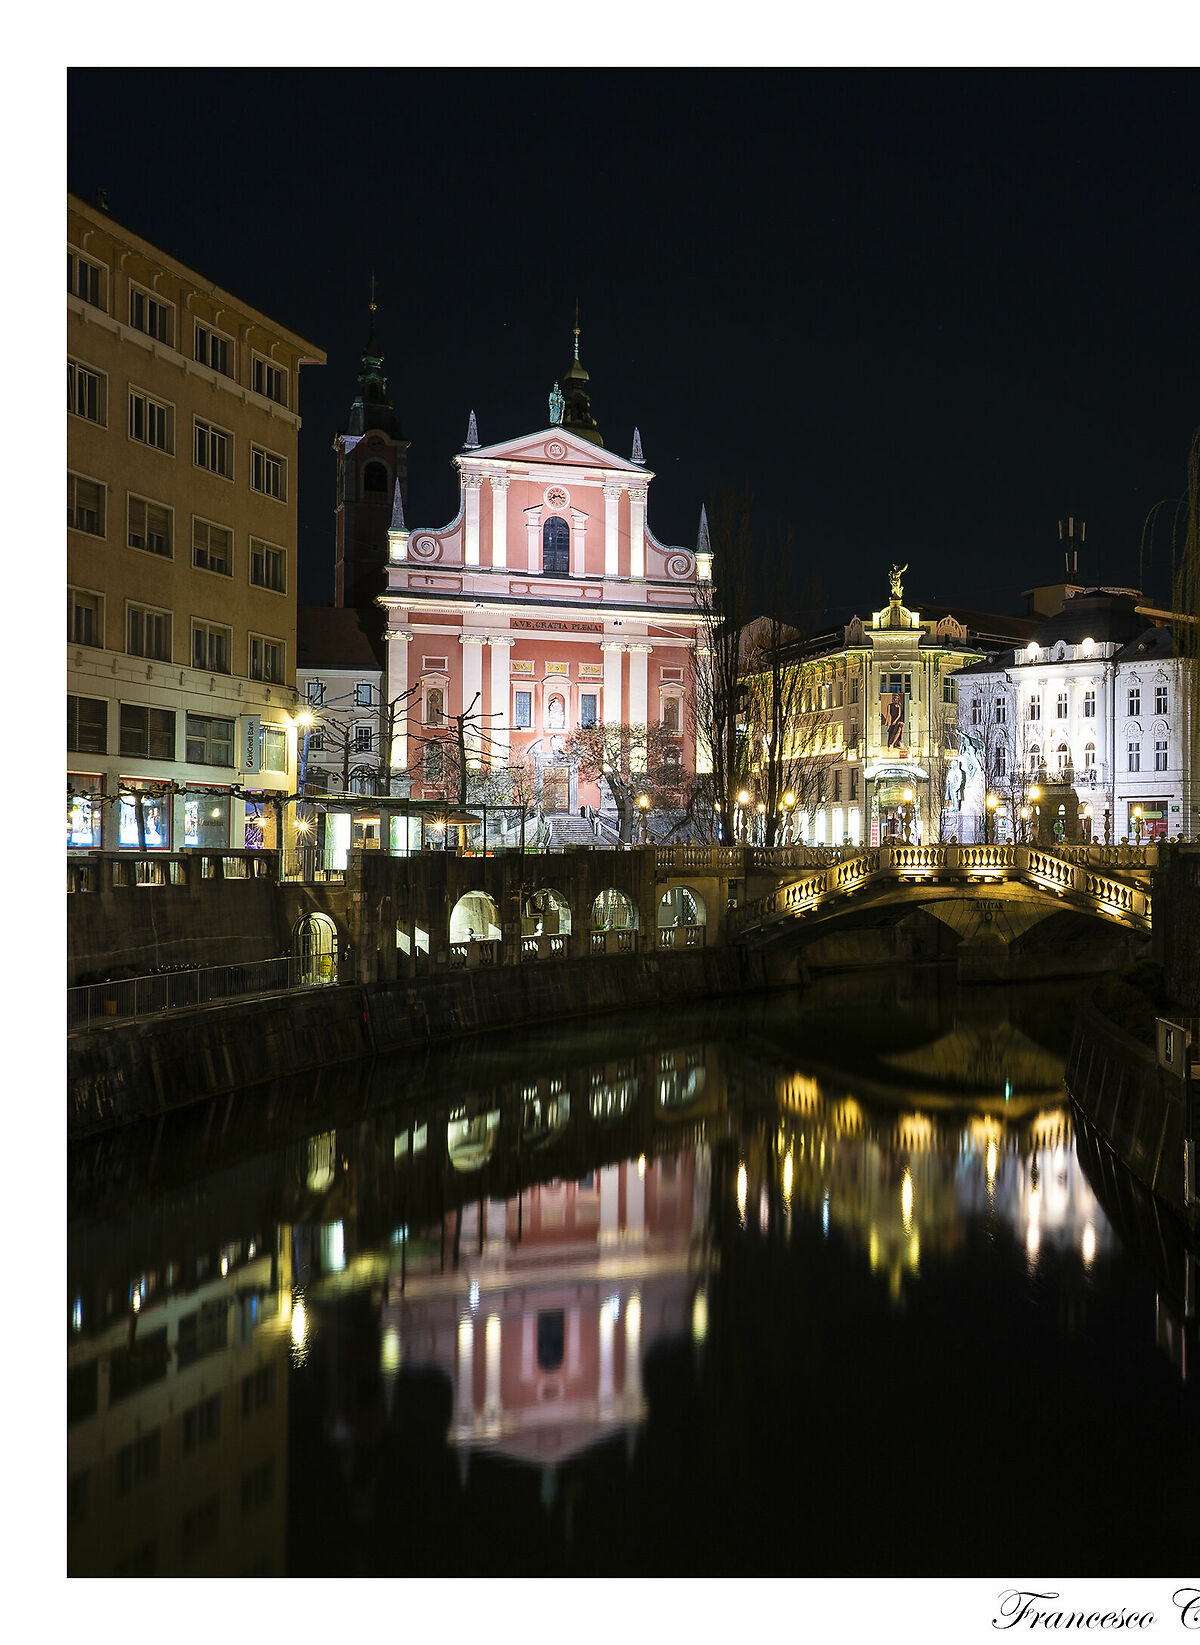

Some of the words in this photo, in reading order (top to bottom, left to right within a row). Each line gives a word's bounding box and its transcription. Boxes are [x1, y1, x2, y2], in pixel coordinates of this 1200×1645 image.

[536, 622, 568, 630] GRATIA
[246, 721, 254, 735] Bank
[246, 736, 254, 761] UniCredit
